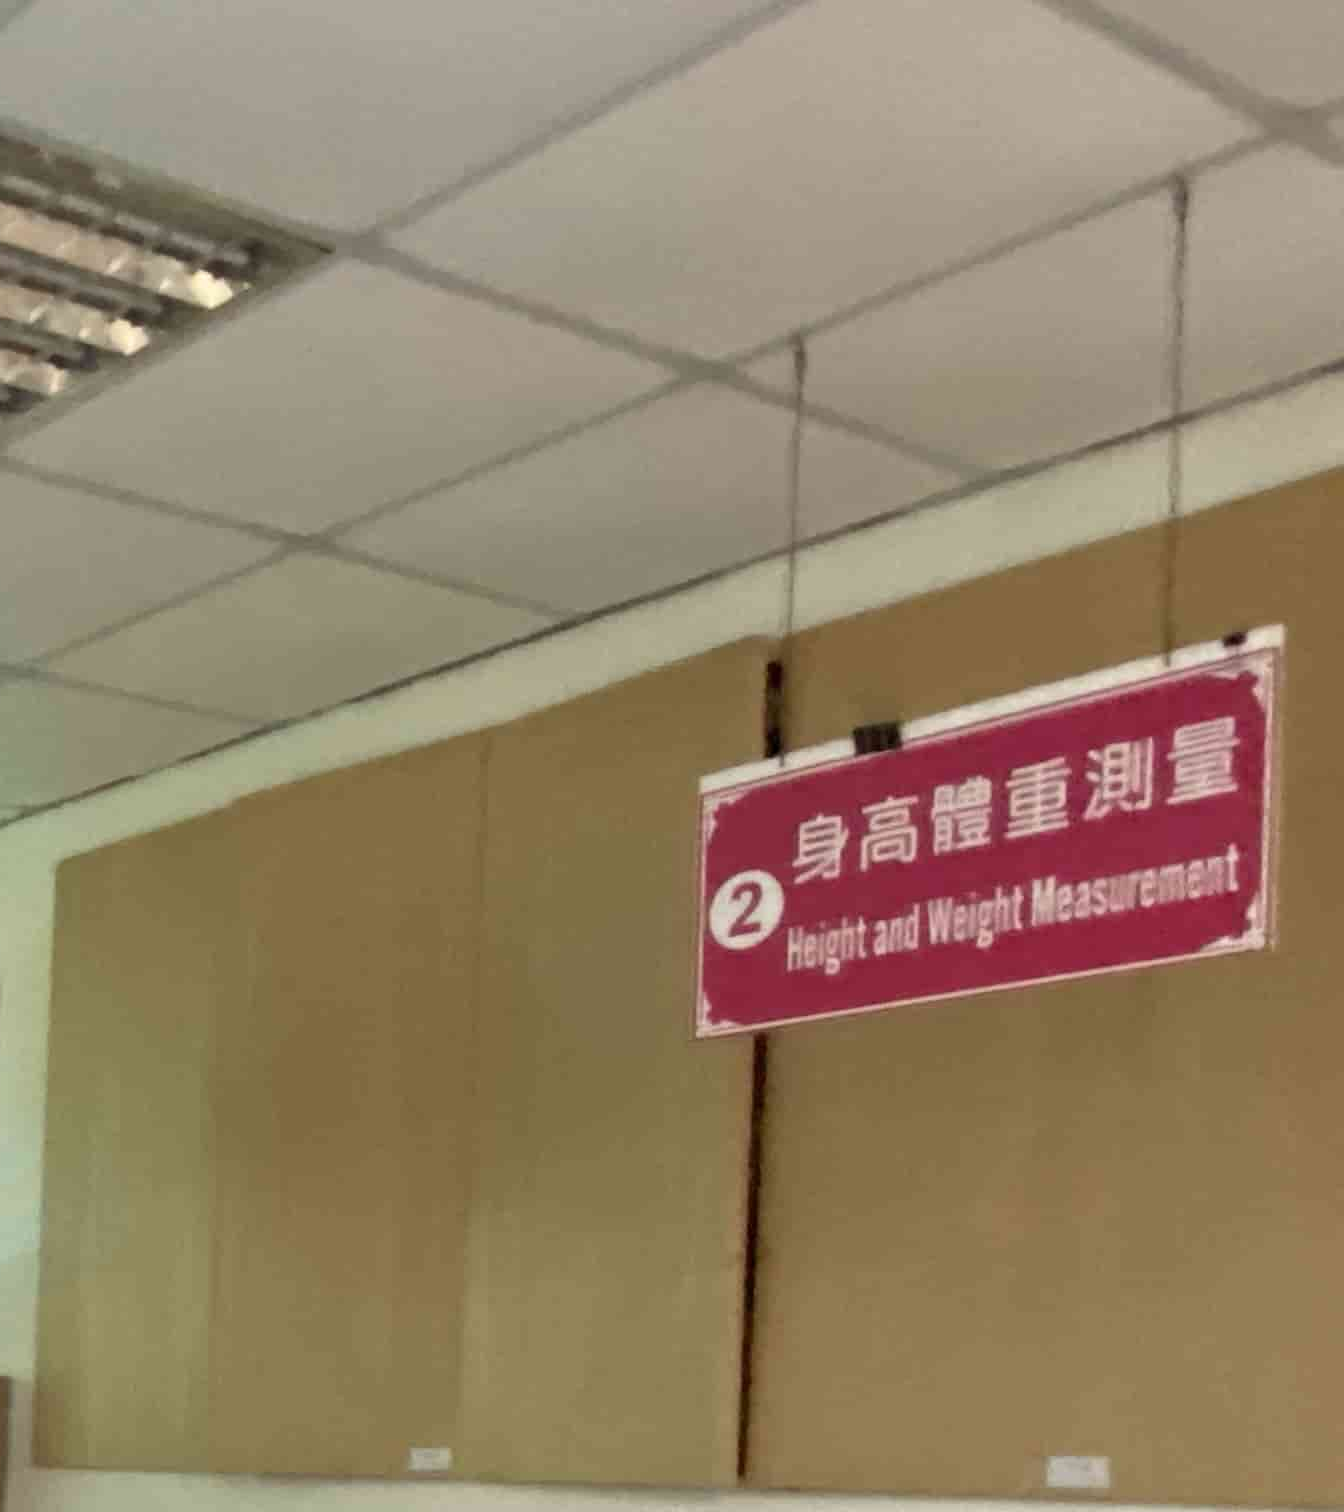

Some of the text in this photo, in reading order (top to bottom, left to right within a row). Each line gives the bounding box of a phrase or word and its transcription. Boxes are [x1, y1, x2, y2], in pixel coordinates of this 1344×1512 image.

[791, 716, 1240, 885] 身高體重測量
[728, 881, 762, 937] 2
[787, 843, 1240, 976] Height and Weight Measurement
